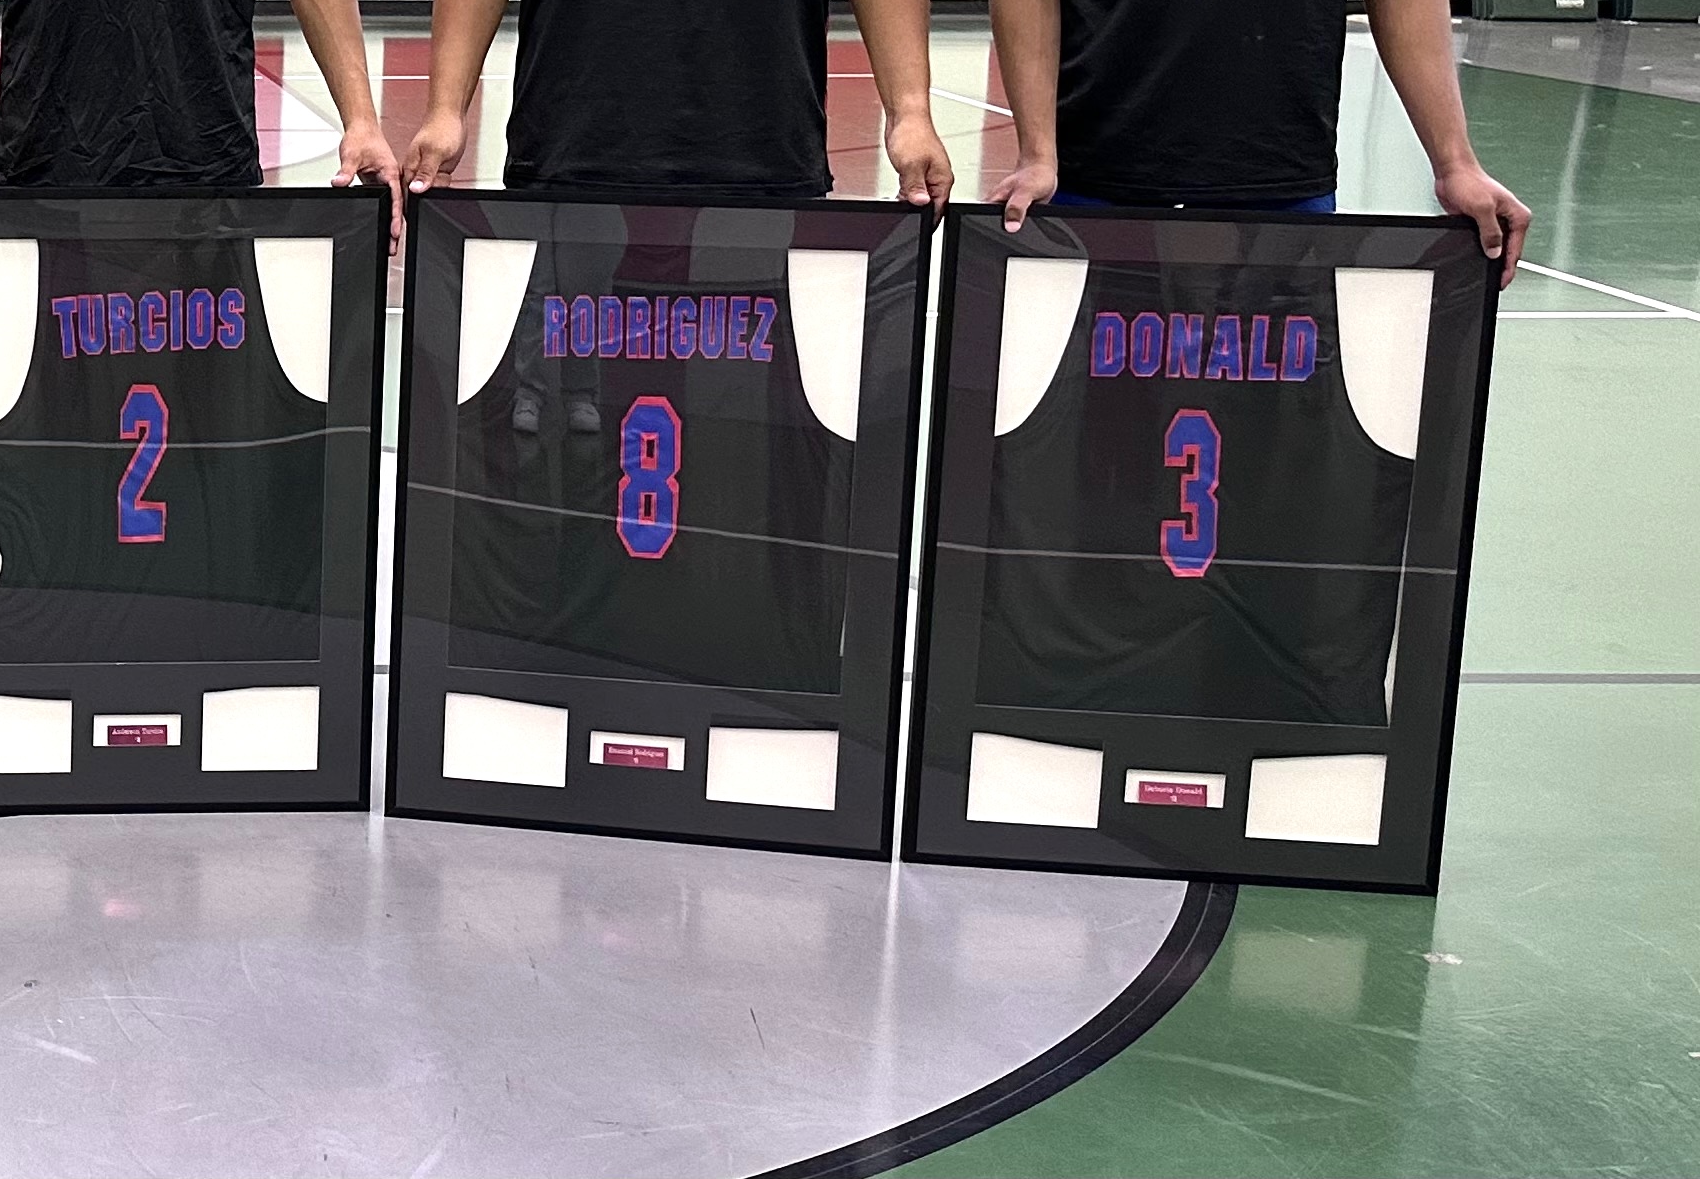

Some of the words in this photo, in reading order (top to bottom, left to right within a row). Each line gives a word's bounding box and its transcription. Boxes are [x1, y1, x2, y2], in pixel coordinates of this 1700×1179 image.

[51, 287, 246, 359] TURCIOS
[543, 294, 778, 363] RODRIGUEZ
[1089, 311, 1319, 382] DONALD
[117, 383, 170, 544] 2
[615, 395, 683, 560] 8
[1159, 408, 1222, 578] 3
